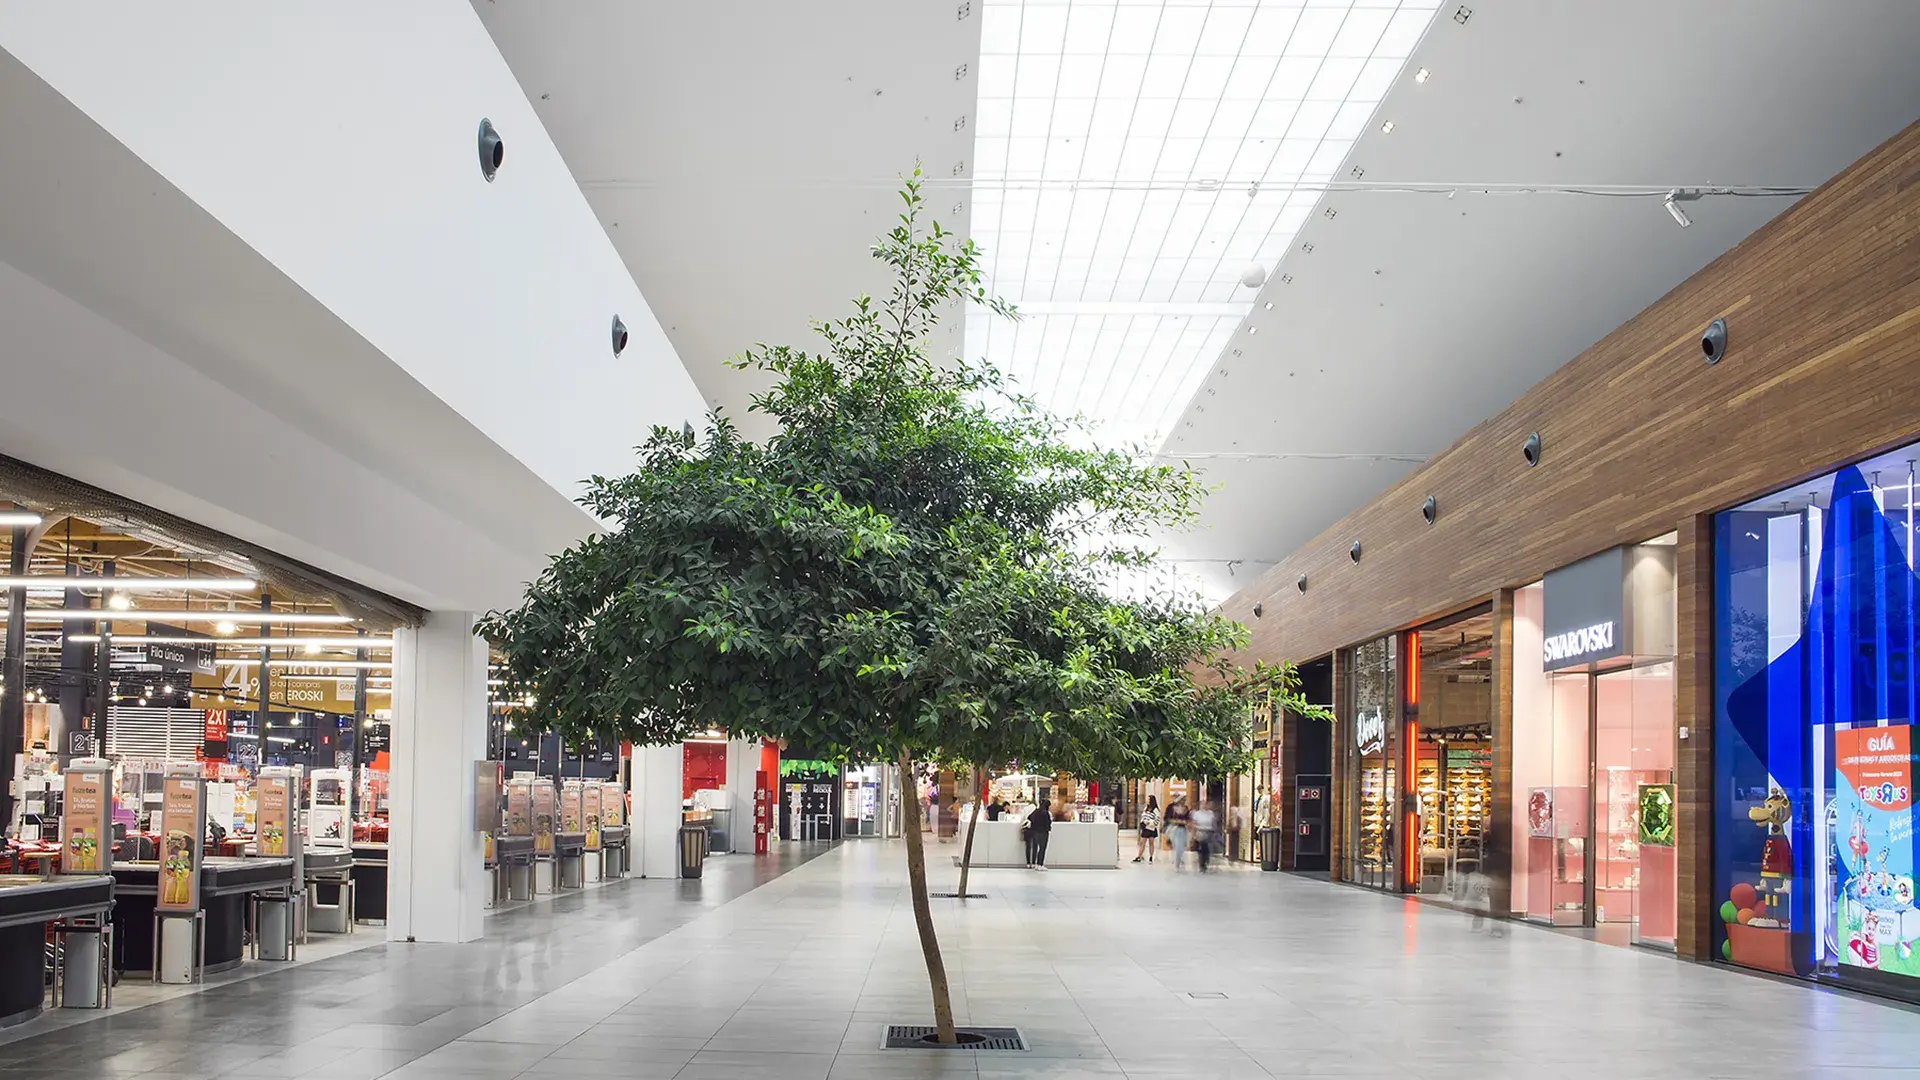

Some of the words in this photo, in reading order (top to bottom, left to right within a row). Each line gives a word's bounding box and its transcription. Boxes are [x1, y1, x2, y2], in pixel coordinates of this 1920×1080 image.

[1544, 621, 1613, 662] SWAROVSKI
[150, 645, 163, 659] Fila
[164, 648, 185, 663] única
[269, 690, 284, 700] en
[287, 689, 323, 701] EROSKI
[1867, 732, 1896, 752] GUÍA
